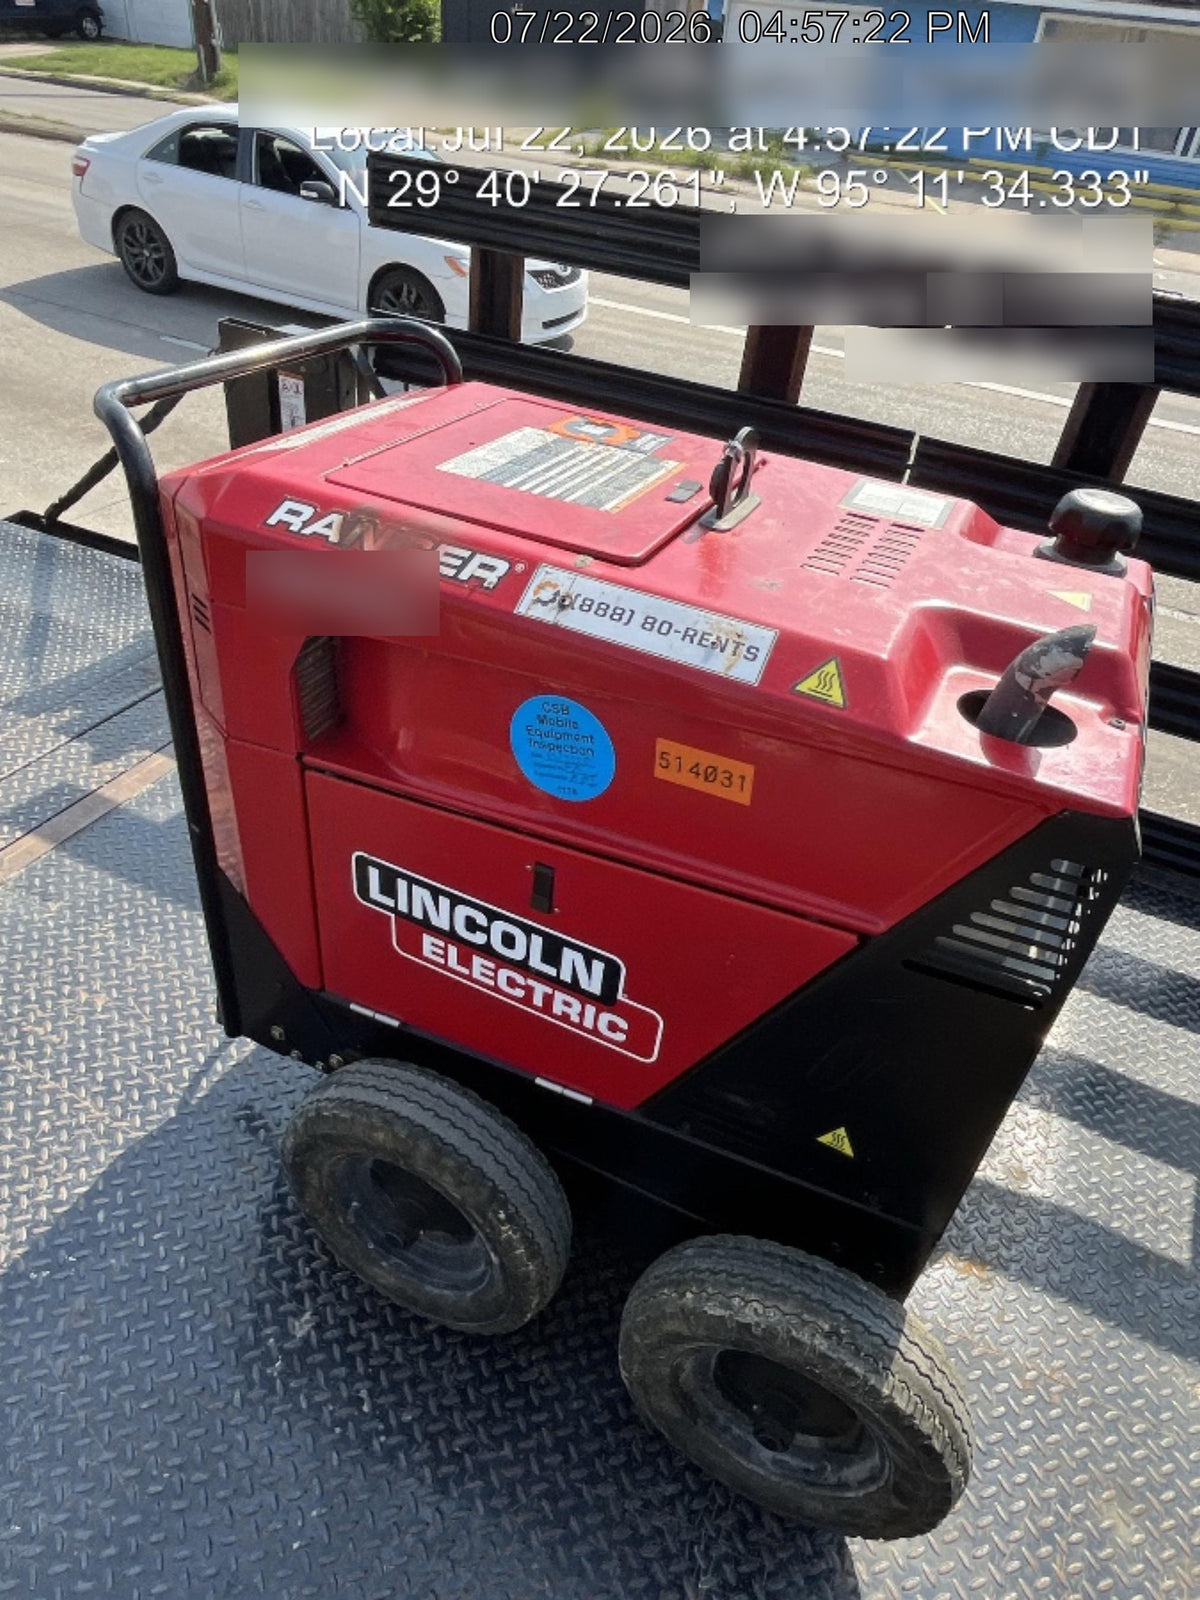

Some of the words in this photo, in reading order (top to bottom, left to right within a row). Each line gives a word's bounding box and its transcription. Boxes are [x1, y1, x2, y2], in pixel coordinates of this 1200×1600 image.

[570, 593, 635, 626] (888)
[641, 615, 761, 662] 80-RENTS
[525, 724, 595, 745] Equipment
[536, 714, 579, 730] Mobile
[528, 738, 595, 757] Inspection
[658, 751, 747, 793] 514031
[367, 864, 606, 998] LINCOLN
[421, 932, 630, 1043] ELECTRIC
